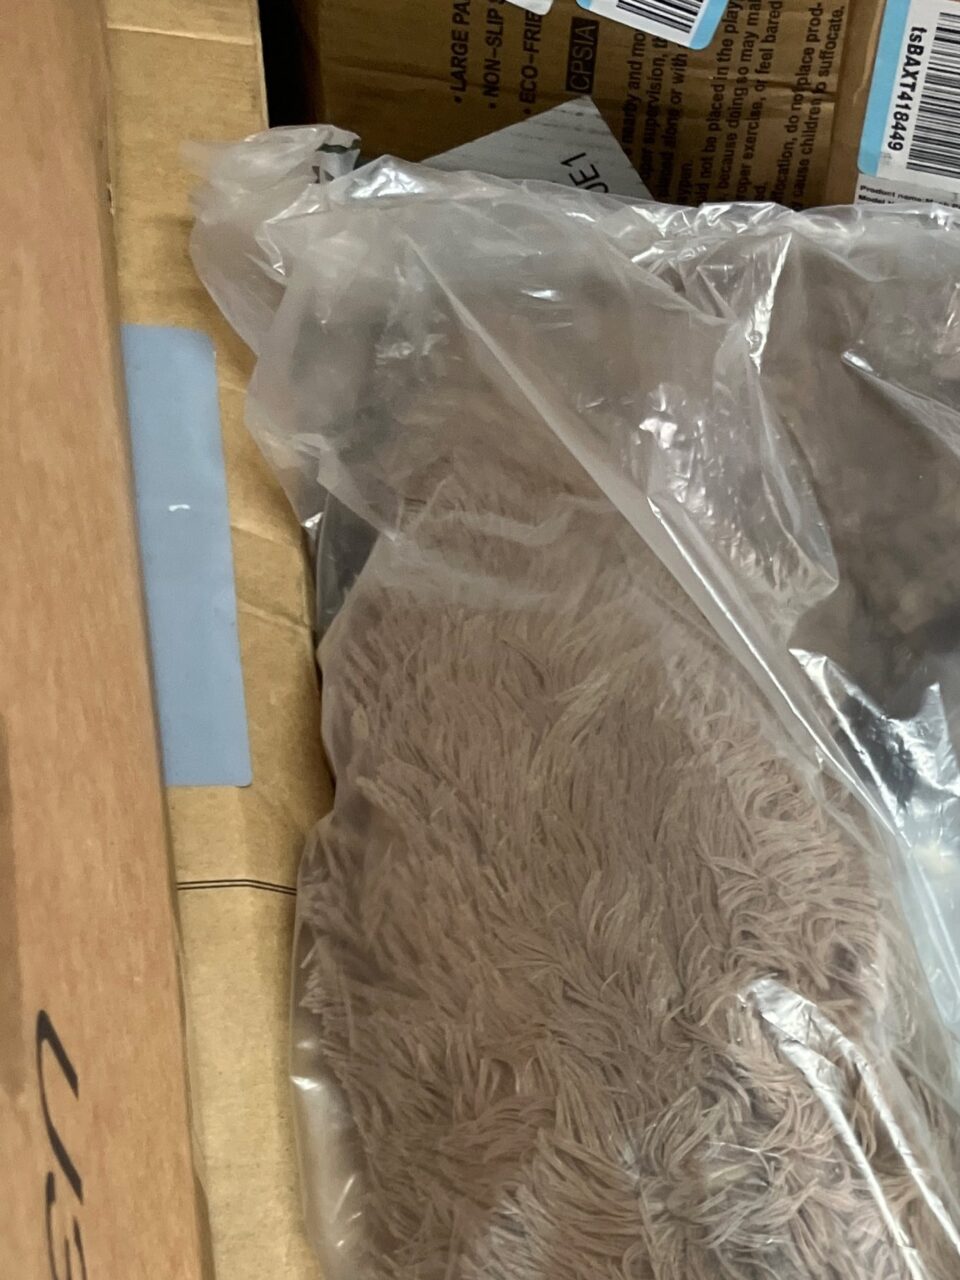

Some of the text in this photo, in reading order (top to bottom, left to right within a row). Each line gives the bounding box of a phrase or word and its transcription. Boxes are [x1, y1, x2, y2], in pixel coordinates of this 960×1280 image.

[631, 29, 647, 57] mo
[761, 0, 783, 44] bared
[818, 5, 846, 78] suffocate.
[450, 29, 469, 92] LARGE
[569, 24, 598, 91] CPSIA
[671, 53, 689, 84] with
[716, 38, 735, 63] the
[754, 48, 774, 75] feel
[784, 115, 800, 134] do
[795, 47, 816, 88] place
[806, 2, 824, 43] prod-
[627, 61, 643, 90] and
[713, 66, 731, 80] in
[717, 0, 761, 190] because doing so may ma
[754, 79, 769, 92] or
[886, 26, 928, 153] tsBAXT418449
[643, 54, 668, 144] supervision,
[670, 88, 683, 105] or
[705, 84, 726, 132] placed
[621, 94, 642, 144] nearby
[743, 97, 767, 160] exercise,
[800, 97, 824, 156] children
[703, 136, 719, 153] be
[700, 156, 714, 180] not
[793, 159, 811, 199] cause
